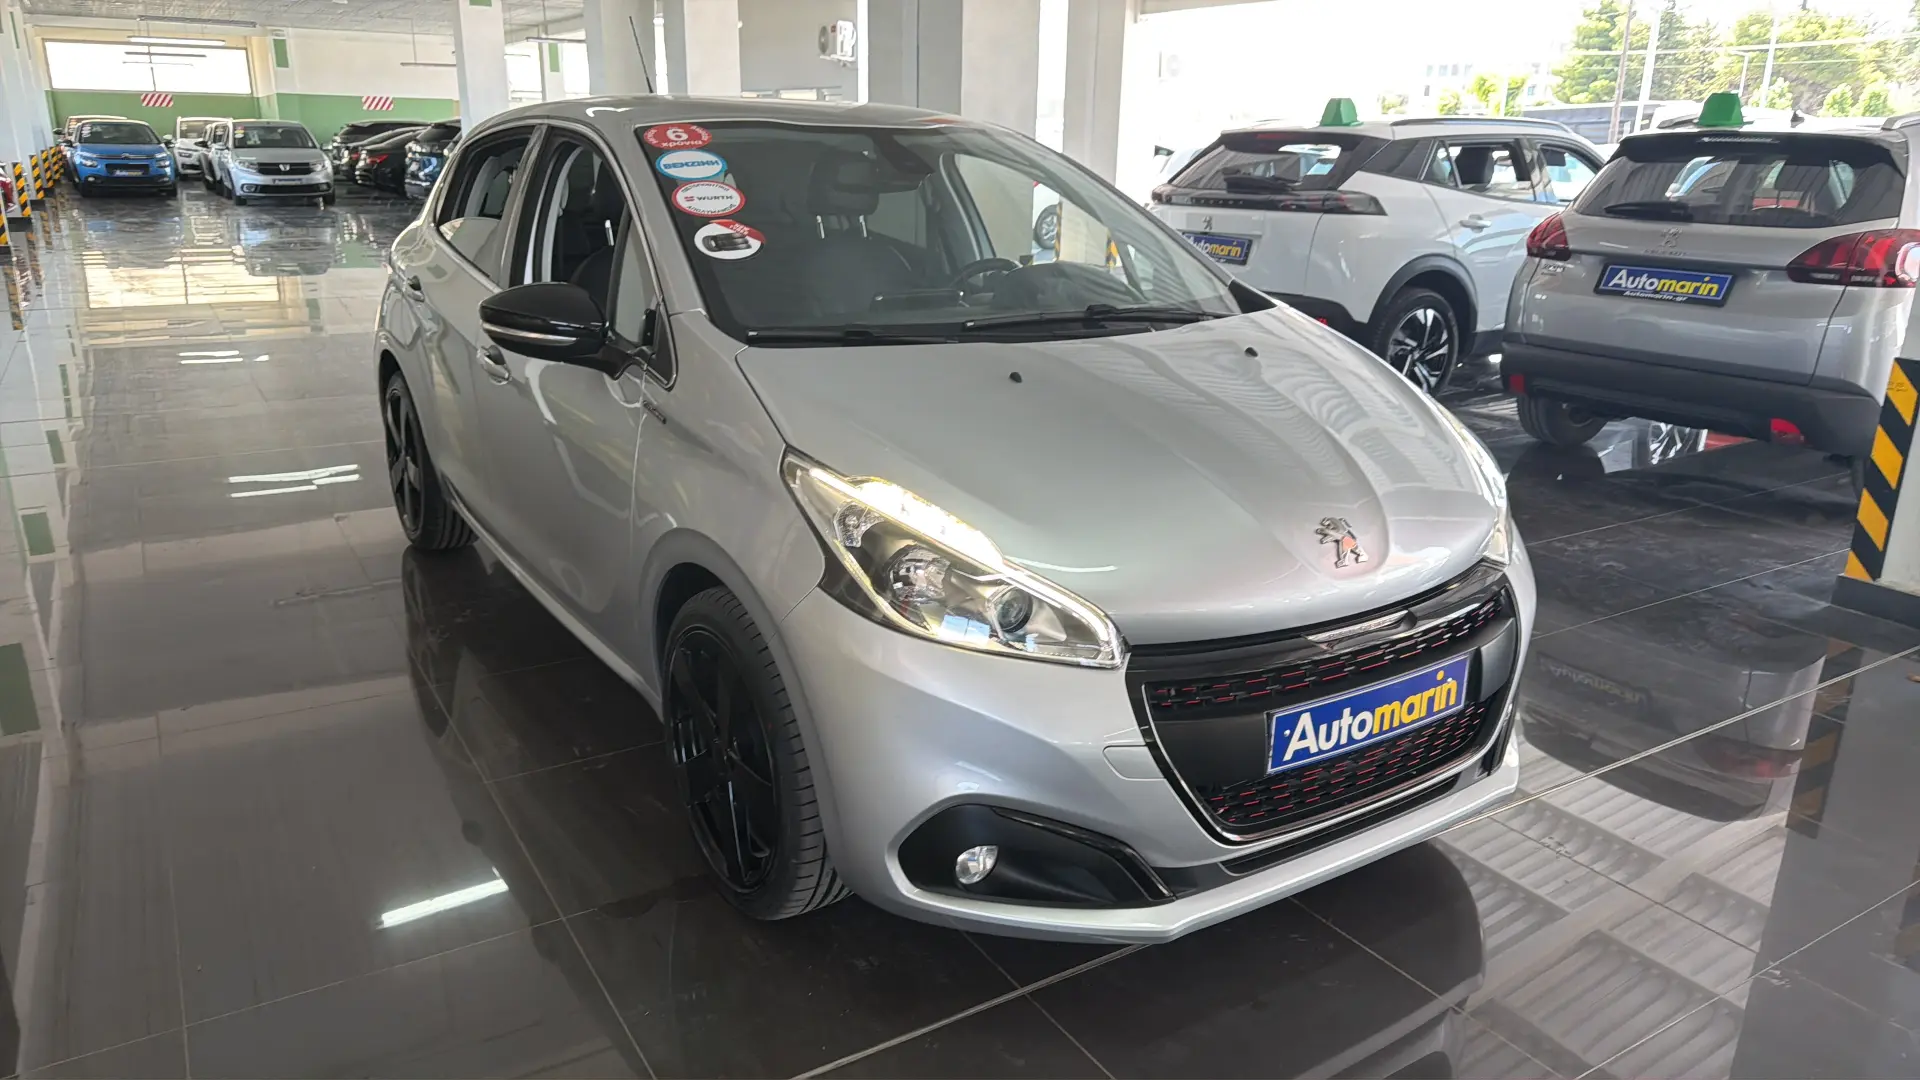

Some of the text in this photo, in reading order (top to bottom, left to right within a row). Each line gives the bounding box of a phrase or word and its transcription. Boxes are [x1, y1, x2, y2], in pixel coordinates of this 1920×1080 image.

[666, 128, 688, 141] 6
[1608, 268, 1719, 297] Automarin
[1624, 290, 1688, 301] Automarin.gr
[1282, 670, 1458, 762] Automarin
